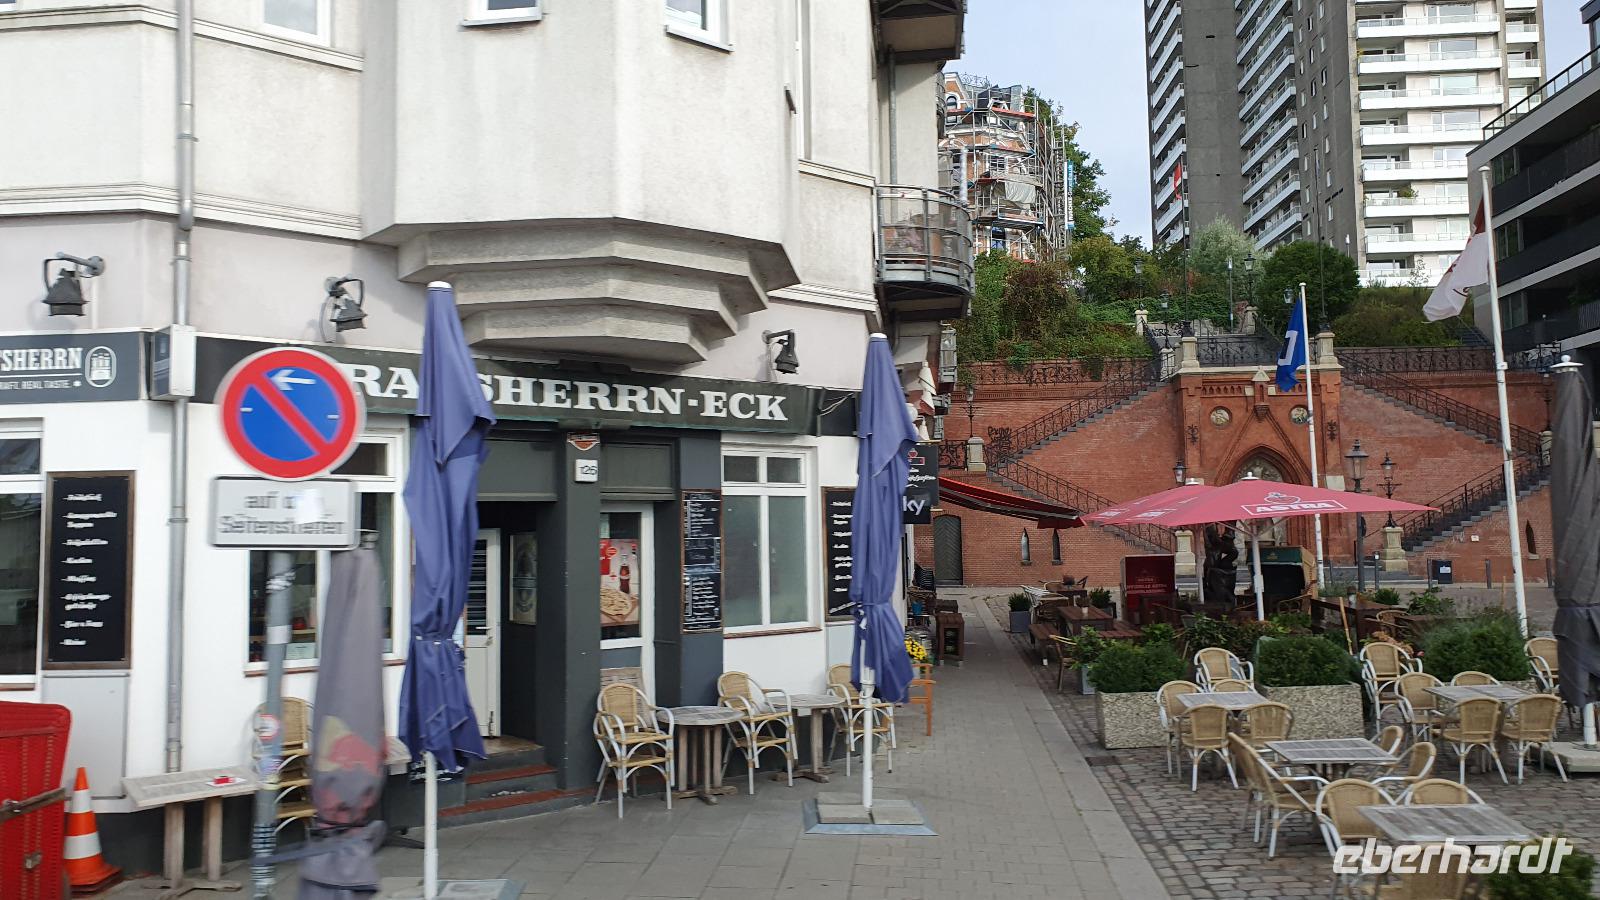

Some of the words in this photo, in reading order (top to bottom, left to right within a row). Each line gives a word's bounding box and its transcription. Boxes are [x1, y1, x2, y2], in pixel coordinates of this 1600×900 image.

[0, 348, 83, 371] SHERRN
[344, 362, 789, 421] RASHERRN-ECK
[903, 495, 926, 515] ky
[1256, 503, 1335, 512] ASTRA
